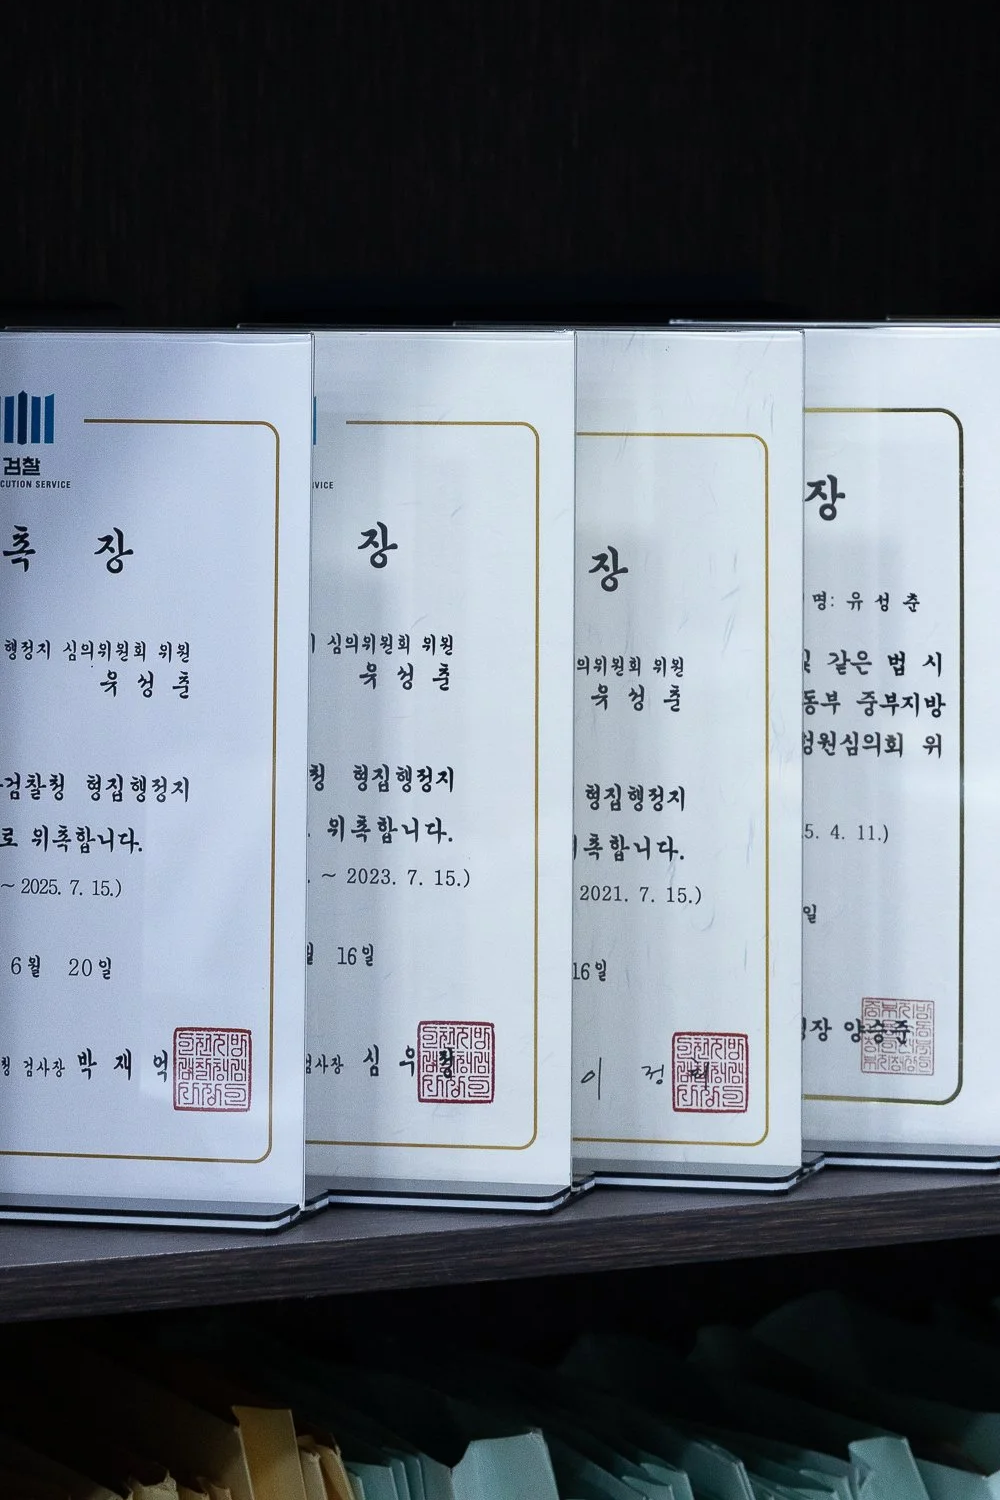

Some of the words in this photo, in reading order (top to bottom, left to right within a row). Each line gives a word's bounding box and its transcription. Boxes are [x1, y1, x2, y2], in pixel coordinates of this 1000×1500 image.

[3, 457, 40, 475] 검찰
[0, 480, 31, 488] CUTION
[804, 475, 845, 521] 장
[3, 525, 36, 572] 촉
[94, 527, 133, 573] 장
[358, 522, 398, 568] 장
[589, 546, 628, 592] 장
[812, 591, 833, 610] 명:
[4, 639, 50, 660] 행정지
[63, 640, 145, 662] 심의위원회
[159, 641, 189, 663] 위원
[327, 633, 409, 655] 심의위원회
[422, 634, 452, 655] 위원
[577, 655, 640, 676] 의위원회
[653, 656, 683, 677] 위원
[828, 650, 872, 675] 같은
[888, 651, 905, 676] 법
[923, 652, 941, 677] 시
[856, 691, 946, 718] 중부지방
[923, 734, 941, 758] 위
[87, 774, 189, 802] 형집행정지
[353, 764, 453, 793] 형집행정지
[585, 783, 684, 812] 형집행정지
[32, 825, 142, 853] 위촉합니다.
[327, 815, 452, 844] 위촉합니다.
[831, 824, 844, 839] 4.
[859, 825, 888, 843] 11.)
[21, 878, 61, 895] 2025.
[70, 880, 82, 895] 7.
[93, 879, 121, 897] 15.)
[347, 868, 395, 885] 2023.
[408, 870, 422, 885] 7.
[435, 869, 469, 888] 15.)
[580, 885, 628, 902] 2021.
[640, 887, 654, 902] 7.
[667, 887, 701, 904] 15.)
[11, 955, 40, 978] 6월
[69, 957, 111, 980] 20일
[338, 944, 373, 966] 16일
[573, 959, 606, 981] 16일
[24, 1057, 65, 1077] 검사장
[78, 1048, 97, 1079] 박
[114, 1049, 131, 1080] 재
[363, 1044, 379, 1077] 심
[399, 1046, 415, 1076] 우
